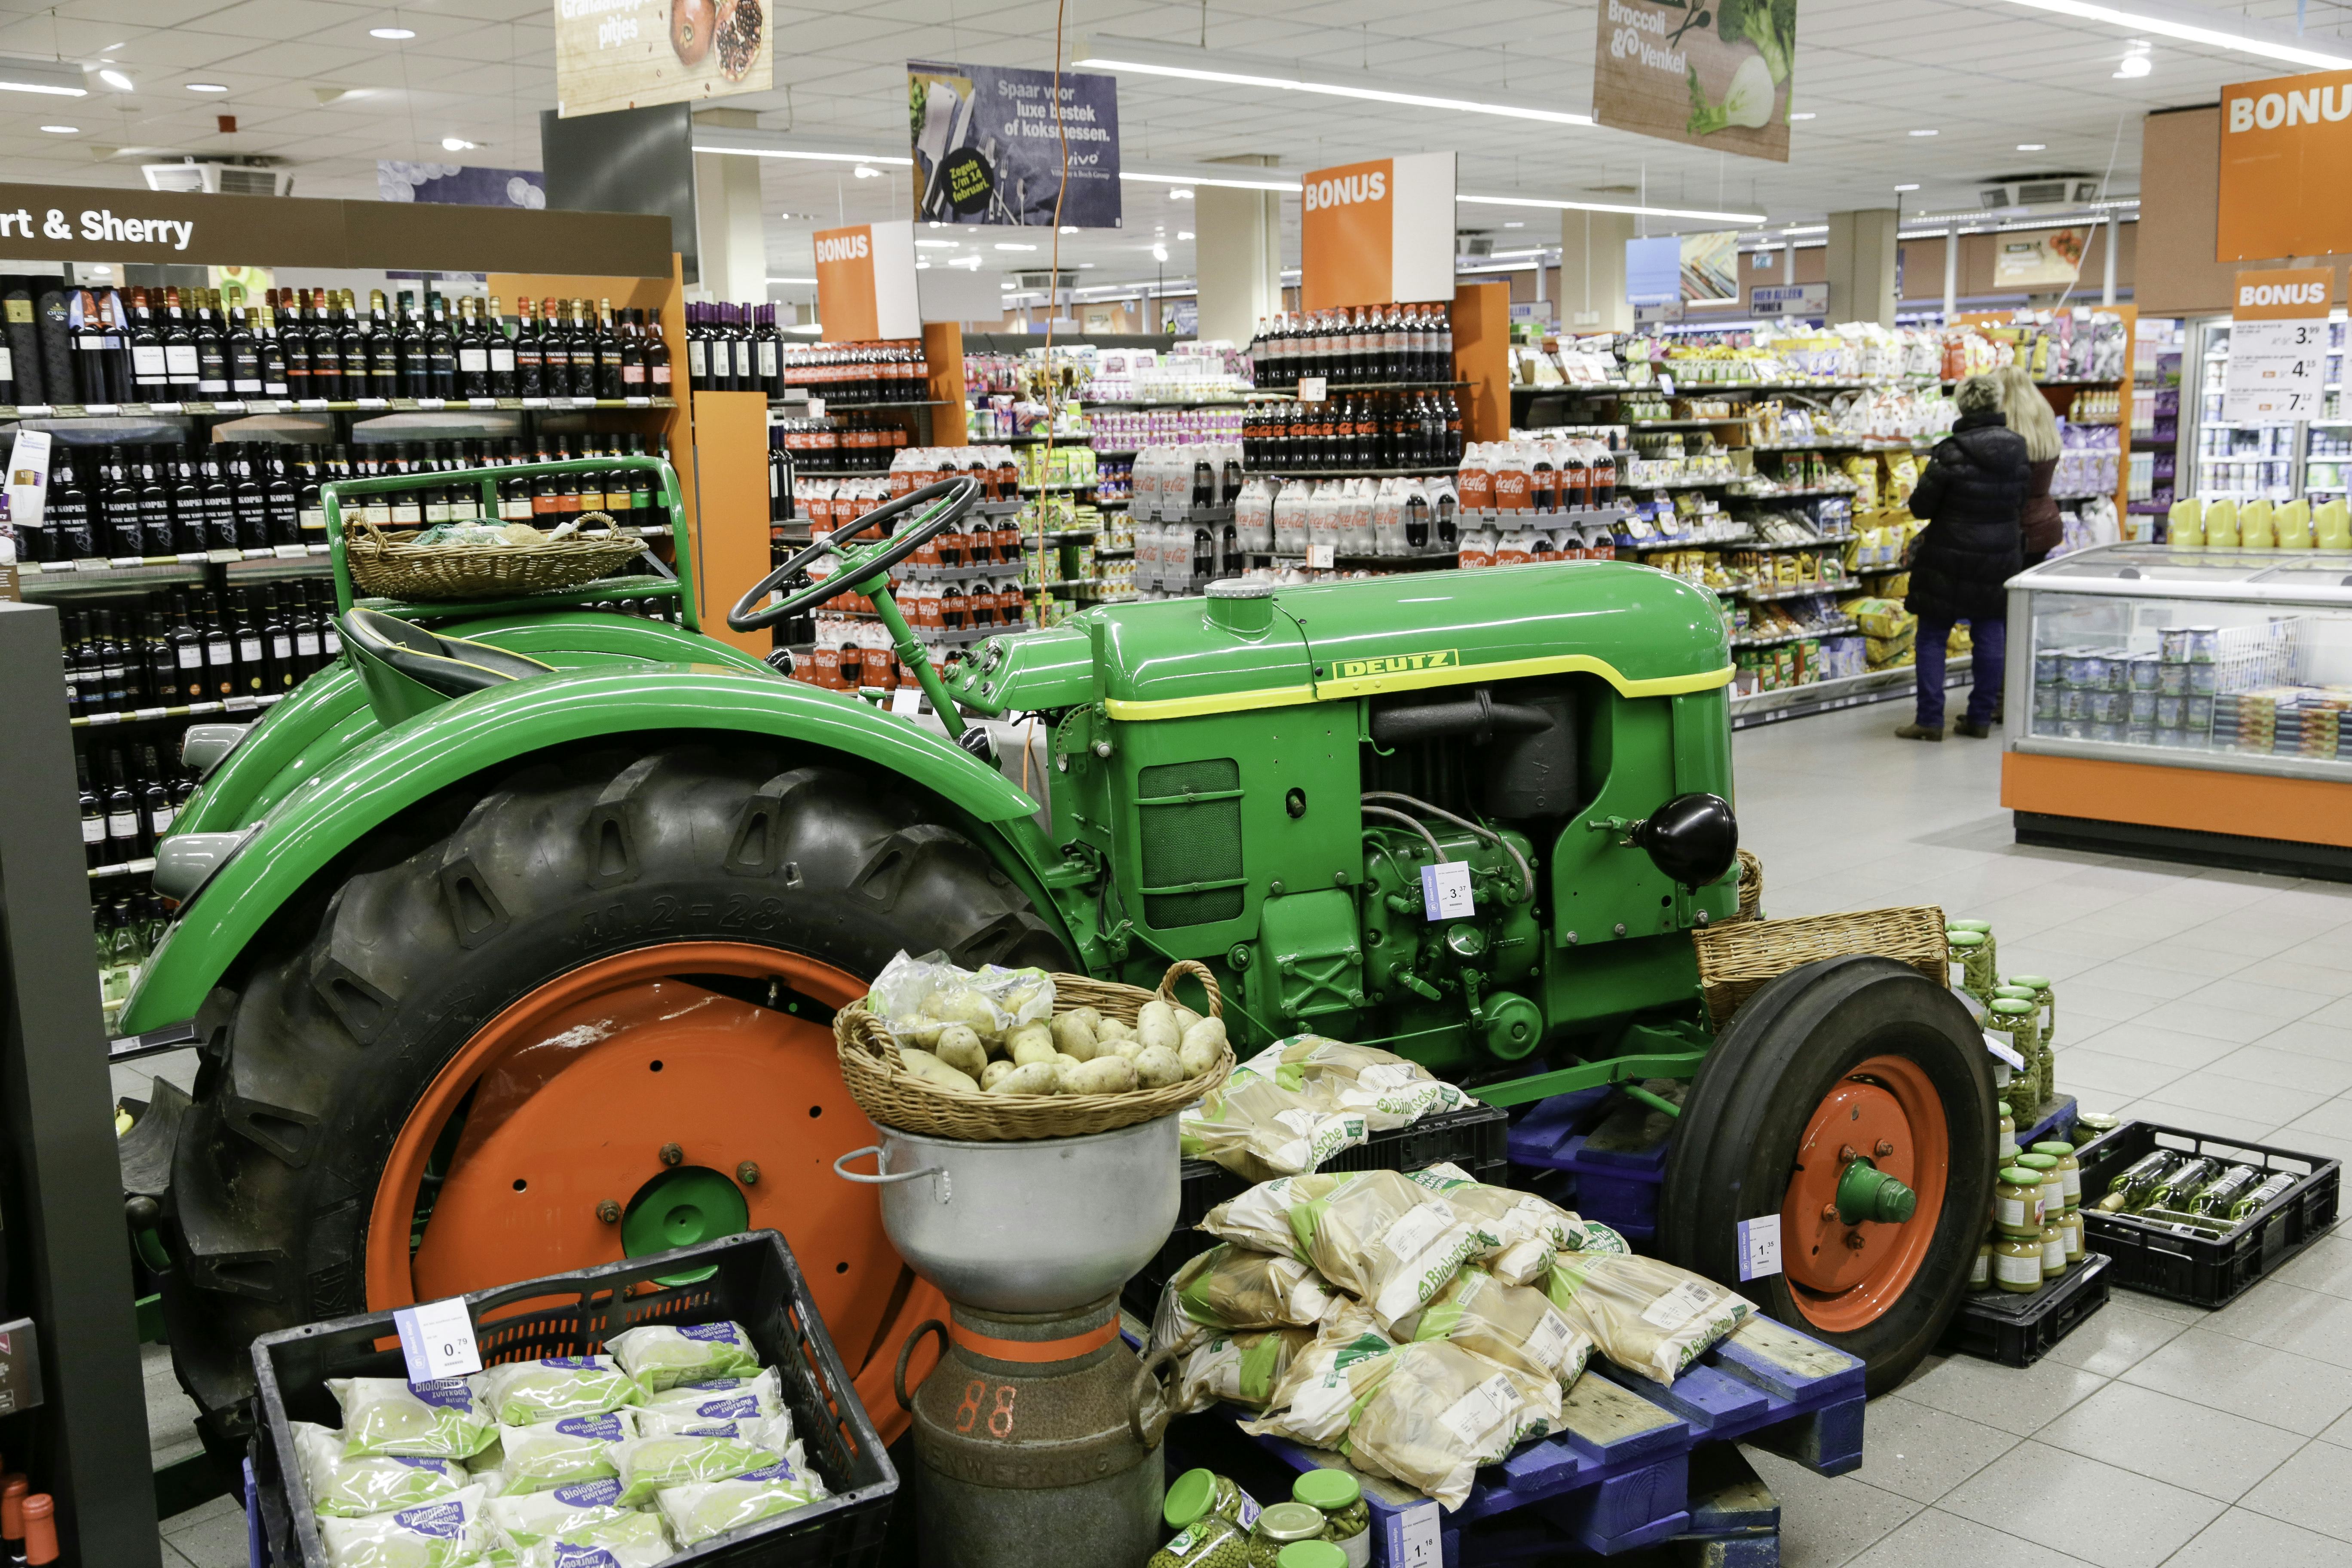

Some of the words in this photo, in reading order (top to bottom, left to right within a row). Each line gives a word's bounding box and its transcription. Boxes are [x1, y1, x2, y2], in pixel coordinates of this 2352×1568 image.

[1608, 0, 1665, 34] Broccoli
[599, 15, 638, 50] pitjes
[1639, 41, 1686, 74] Venkel
[998, 79, 1040, 99] Spaar
[1017, 100, 1046, 118] luxe
[1050, 103, 1096, 122] bestek
[1004, 121, 1019, 136] of
[1023, 121, 1111, 142] koksmessen.
[949, 159, 978, 179] Zegels
[970, 168, 983, 182] 14
[952, 178, 990, 202] februari.
[1305, 171, 1386, 212] BONUS
[43, 209, 72, 239] &
[80, 209, 193, 251] Sherry
[816, 234, 869, 263] BONUS
[2239, 282, 2326, 307] BONUS
[109, 502, 138, 511] KOPKE
[1344, 652, 1449, 677] DEUTZ
[1425, 1231, 1477, 1290] Biologisch
[681, 1322, 730, 1337] Biologische
[416, 1378, 467, 1393] Biologisc
[955, 1380, 1017, 1438] 88
[562, 1418, 617, 1433] Biologische
[561, 1479, 616, 1501] Biologische
[596, 1492, 617, 1503] Naturel
